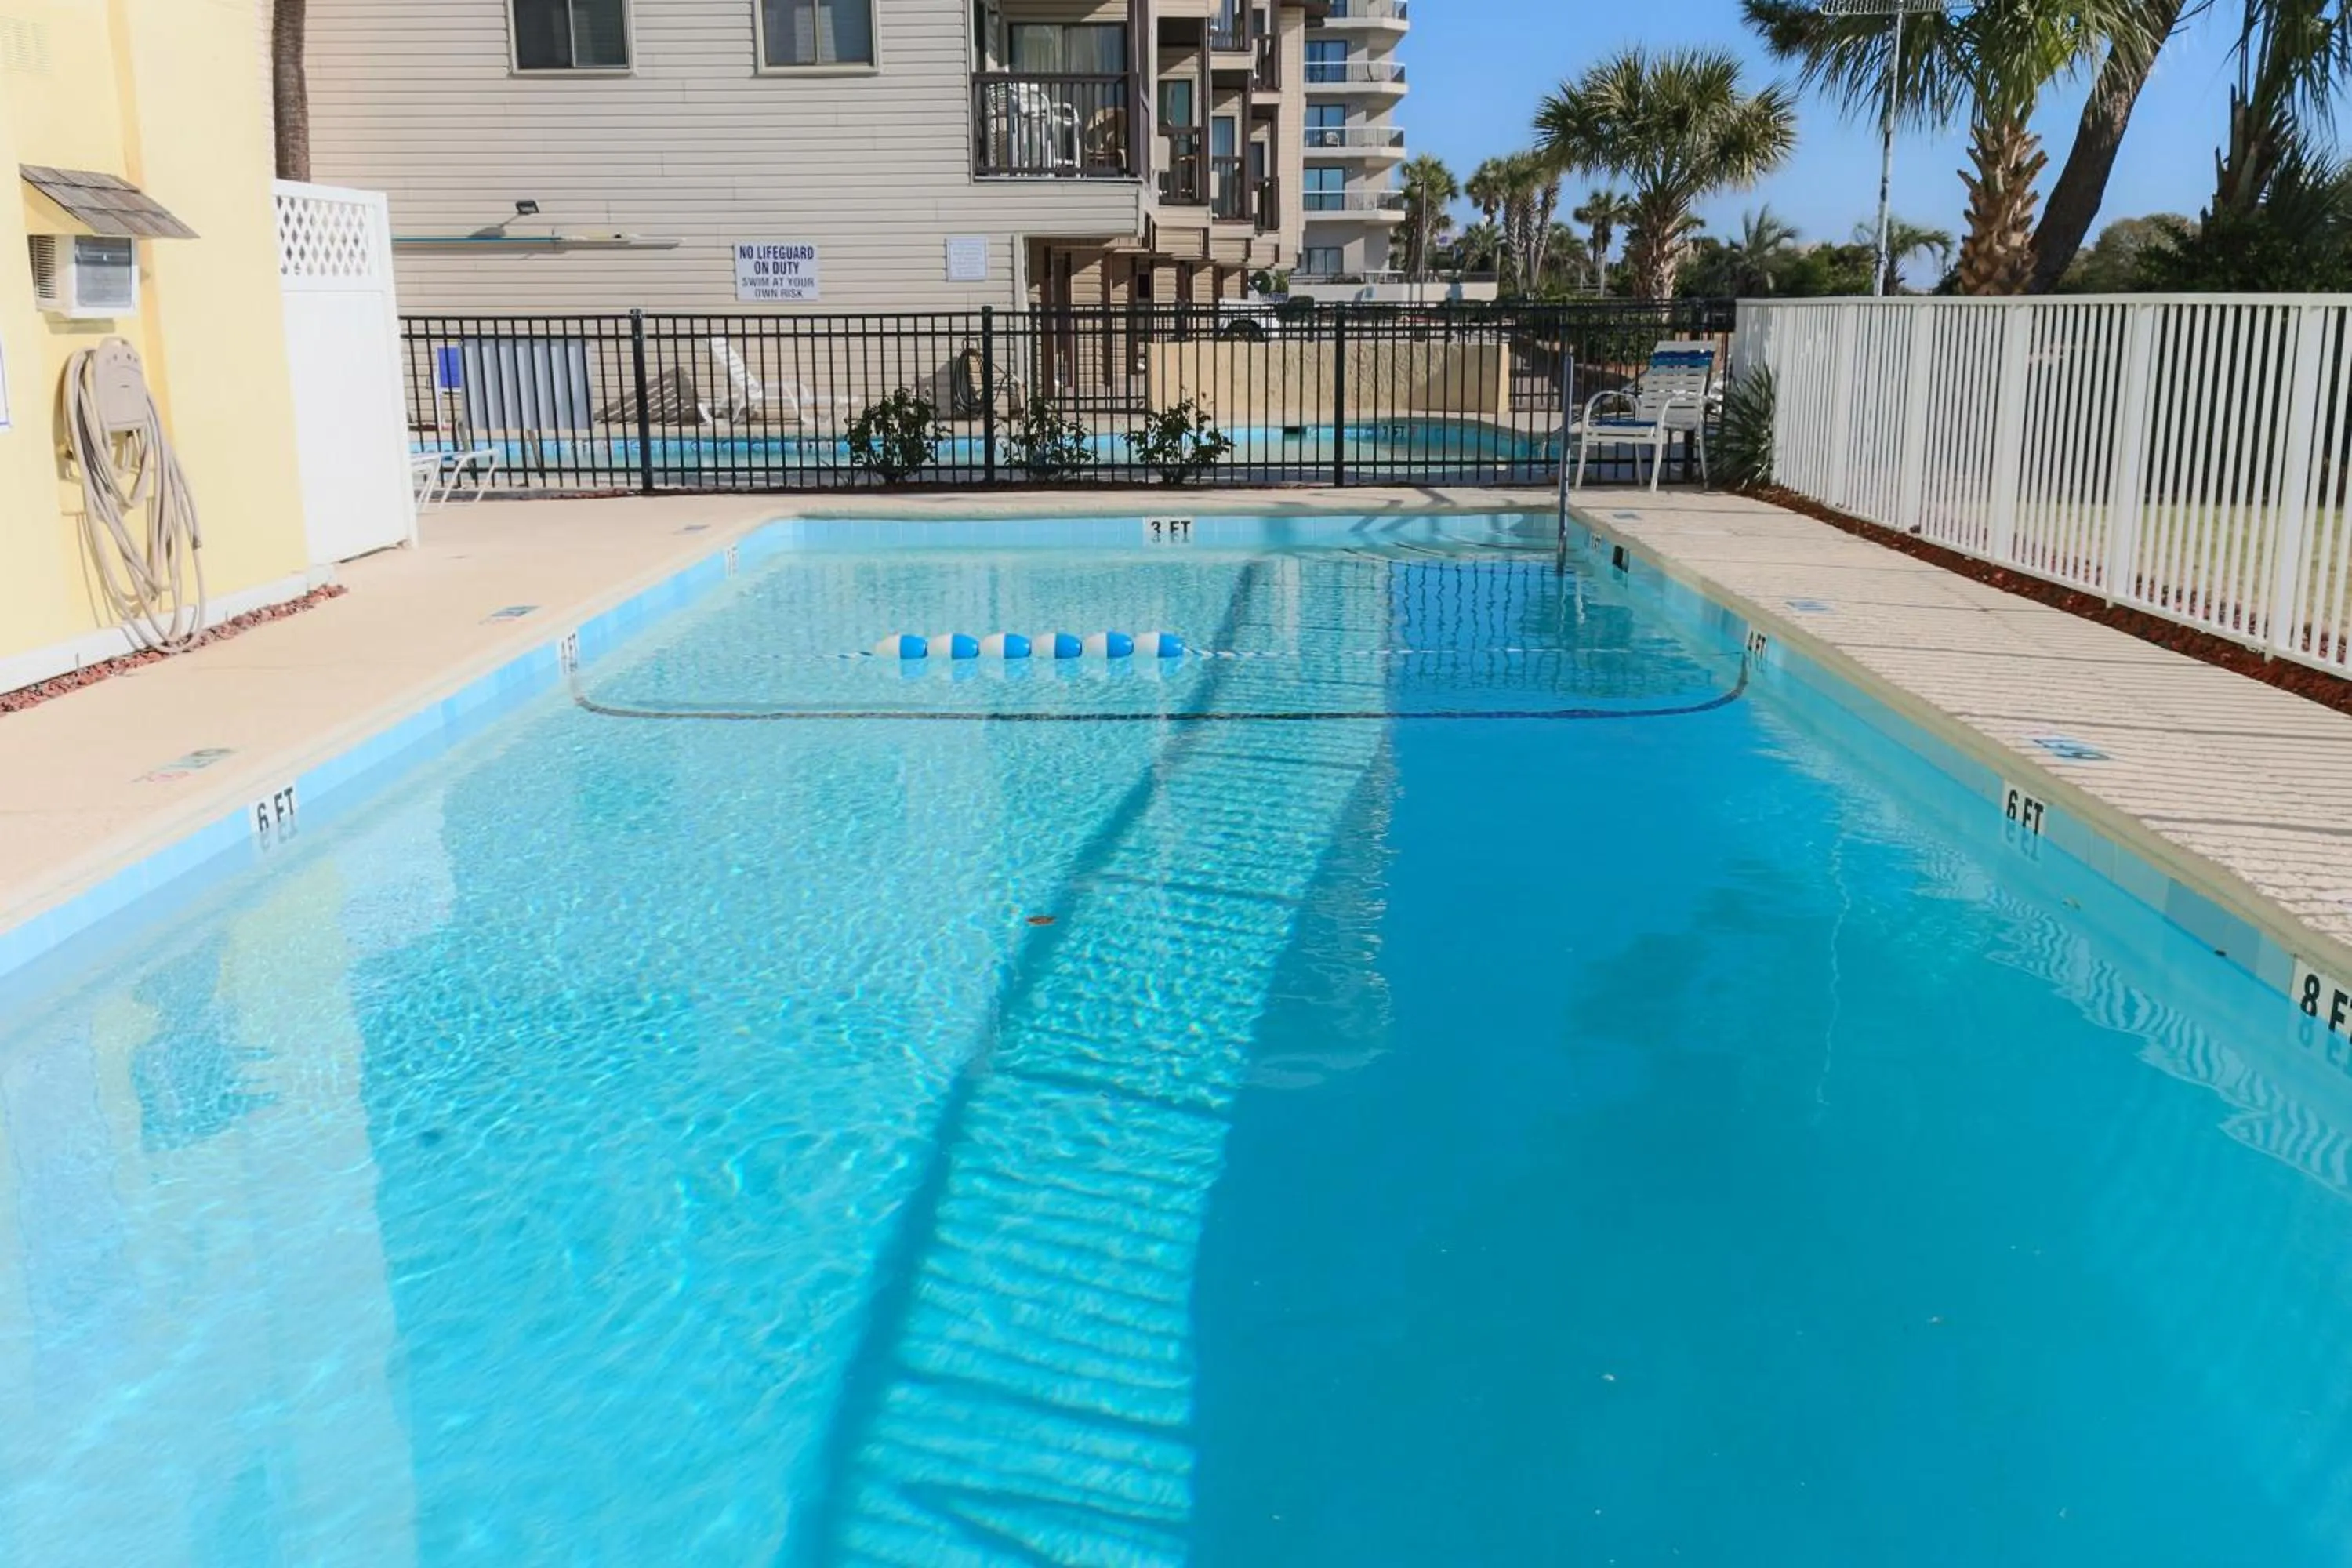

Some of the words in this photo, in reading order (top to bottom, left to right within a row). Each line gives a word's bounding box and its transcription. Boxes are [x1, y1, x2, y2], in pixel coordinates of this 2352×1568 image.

[739, 245, 753, 260] NO
[757, 245, 815, 260] LIFEGUARD
[753, 261, 769, 275] ON
[772, 261, 799, 275] DUTY
[742, 278, 769, 288] SWIM
[772, 278, 783, 287] AT
[787, 278, 815, 288] YOUR
[754, 289, 778, 298] OWN
[780, 289, 803, 298] RISK
[1151, 521, 1162, 534] 3
[1169, 521, 1191, 534] FT
[274, 786, 294, 823] FT
[2007, 789, 2019, 821] 6
[2022, 797, 2045, 836] FT
[2300, 974, 2321, 1018] 8
[2328, 989, 2352, 1044] F
